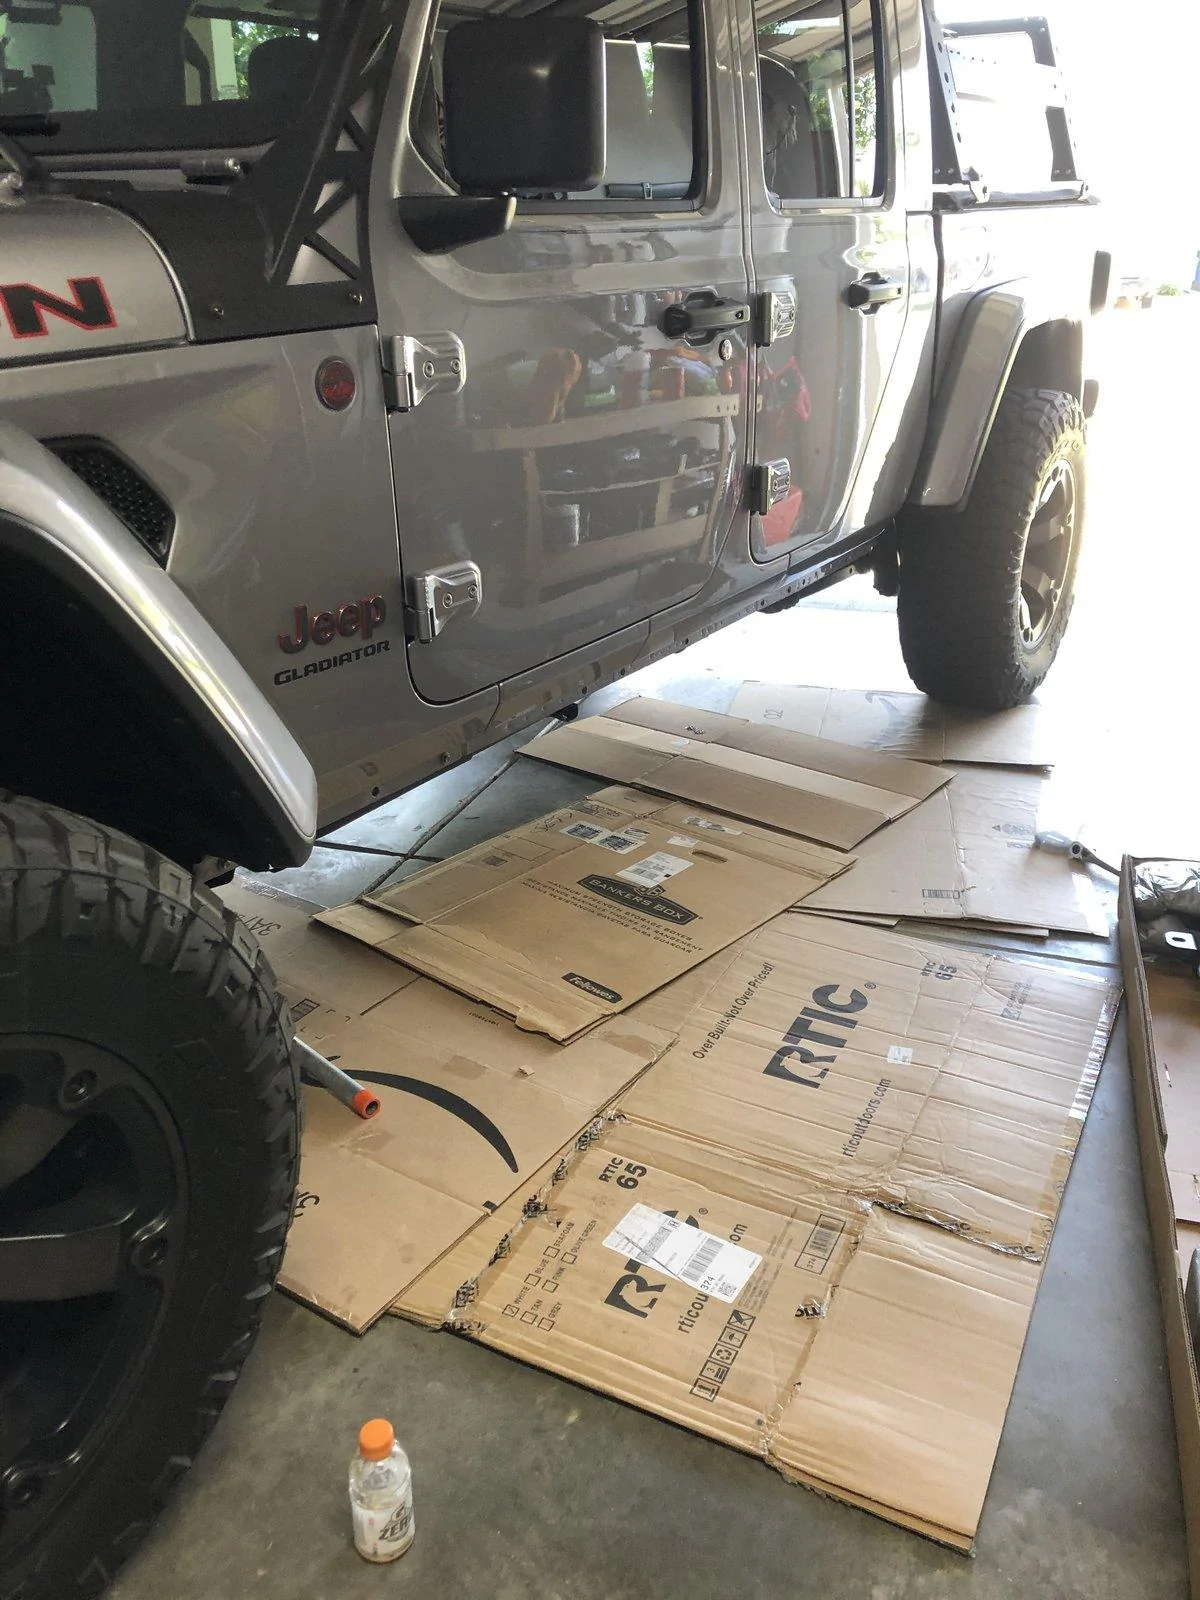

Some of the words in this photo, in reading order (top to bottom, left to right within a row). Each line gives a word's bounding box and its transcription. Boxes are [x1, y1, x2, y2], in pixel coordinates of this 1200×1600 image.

[278, 594, 386, 654] Jeep
[274, 640, 391, 686] GLADIATOR
[588, 879, 653, 906] BANKERS
[653, 903, 685, 920] BOX
[624, 911, 662, 929] STORAGE
[663, 927, 693, 941] BOXES
[569, 976, 615, 1000] Fellowes
[692, 1039, 715, 1059] Over
[734, 987, 755, 1006] Over
[747, 961, 776, 989] Priced!
[762, 984, 868, 1089] RTIC
[842, 1077, 892, 1159] rticoutdoors.com
[598, 1157, 624, 1183] RTIC
[616, 1162, 648, 1190] 65
[514, 1286, 531, 1305] WHITE
[700, 1276, 716, 1291] 374
[530, 1298, 544, 1311] TAN
